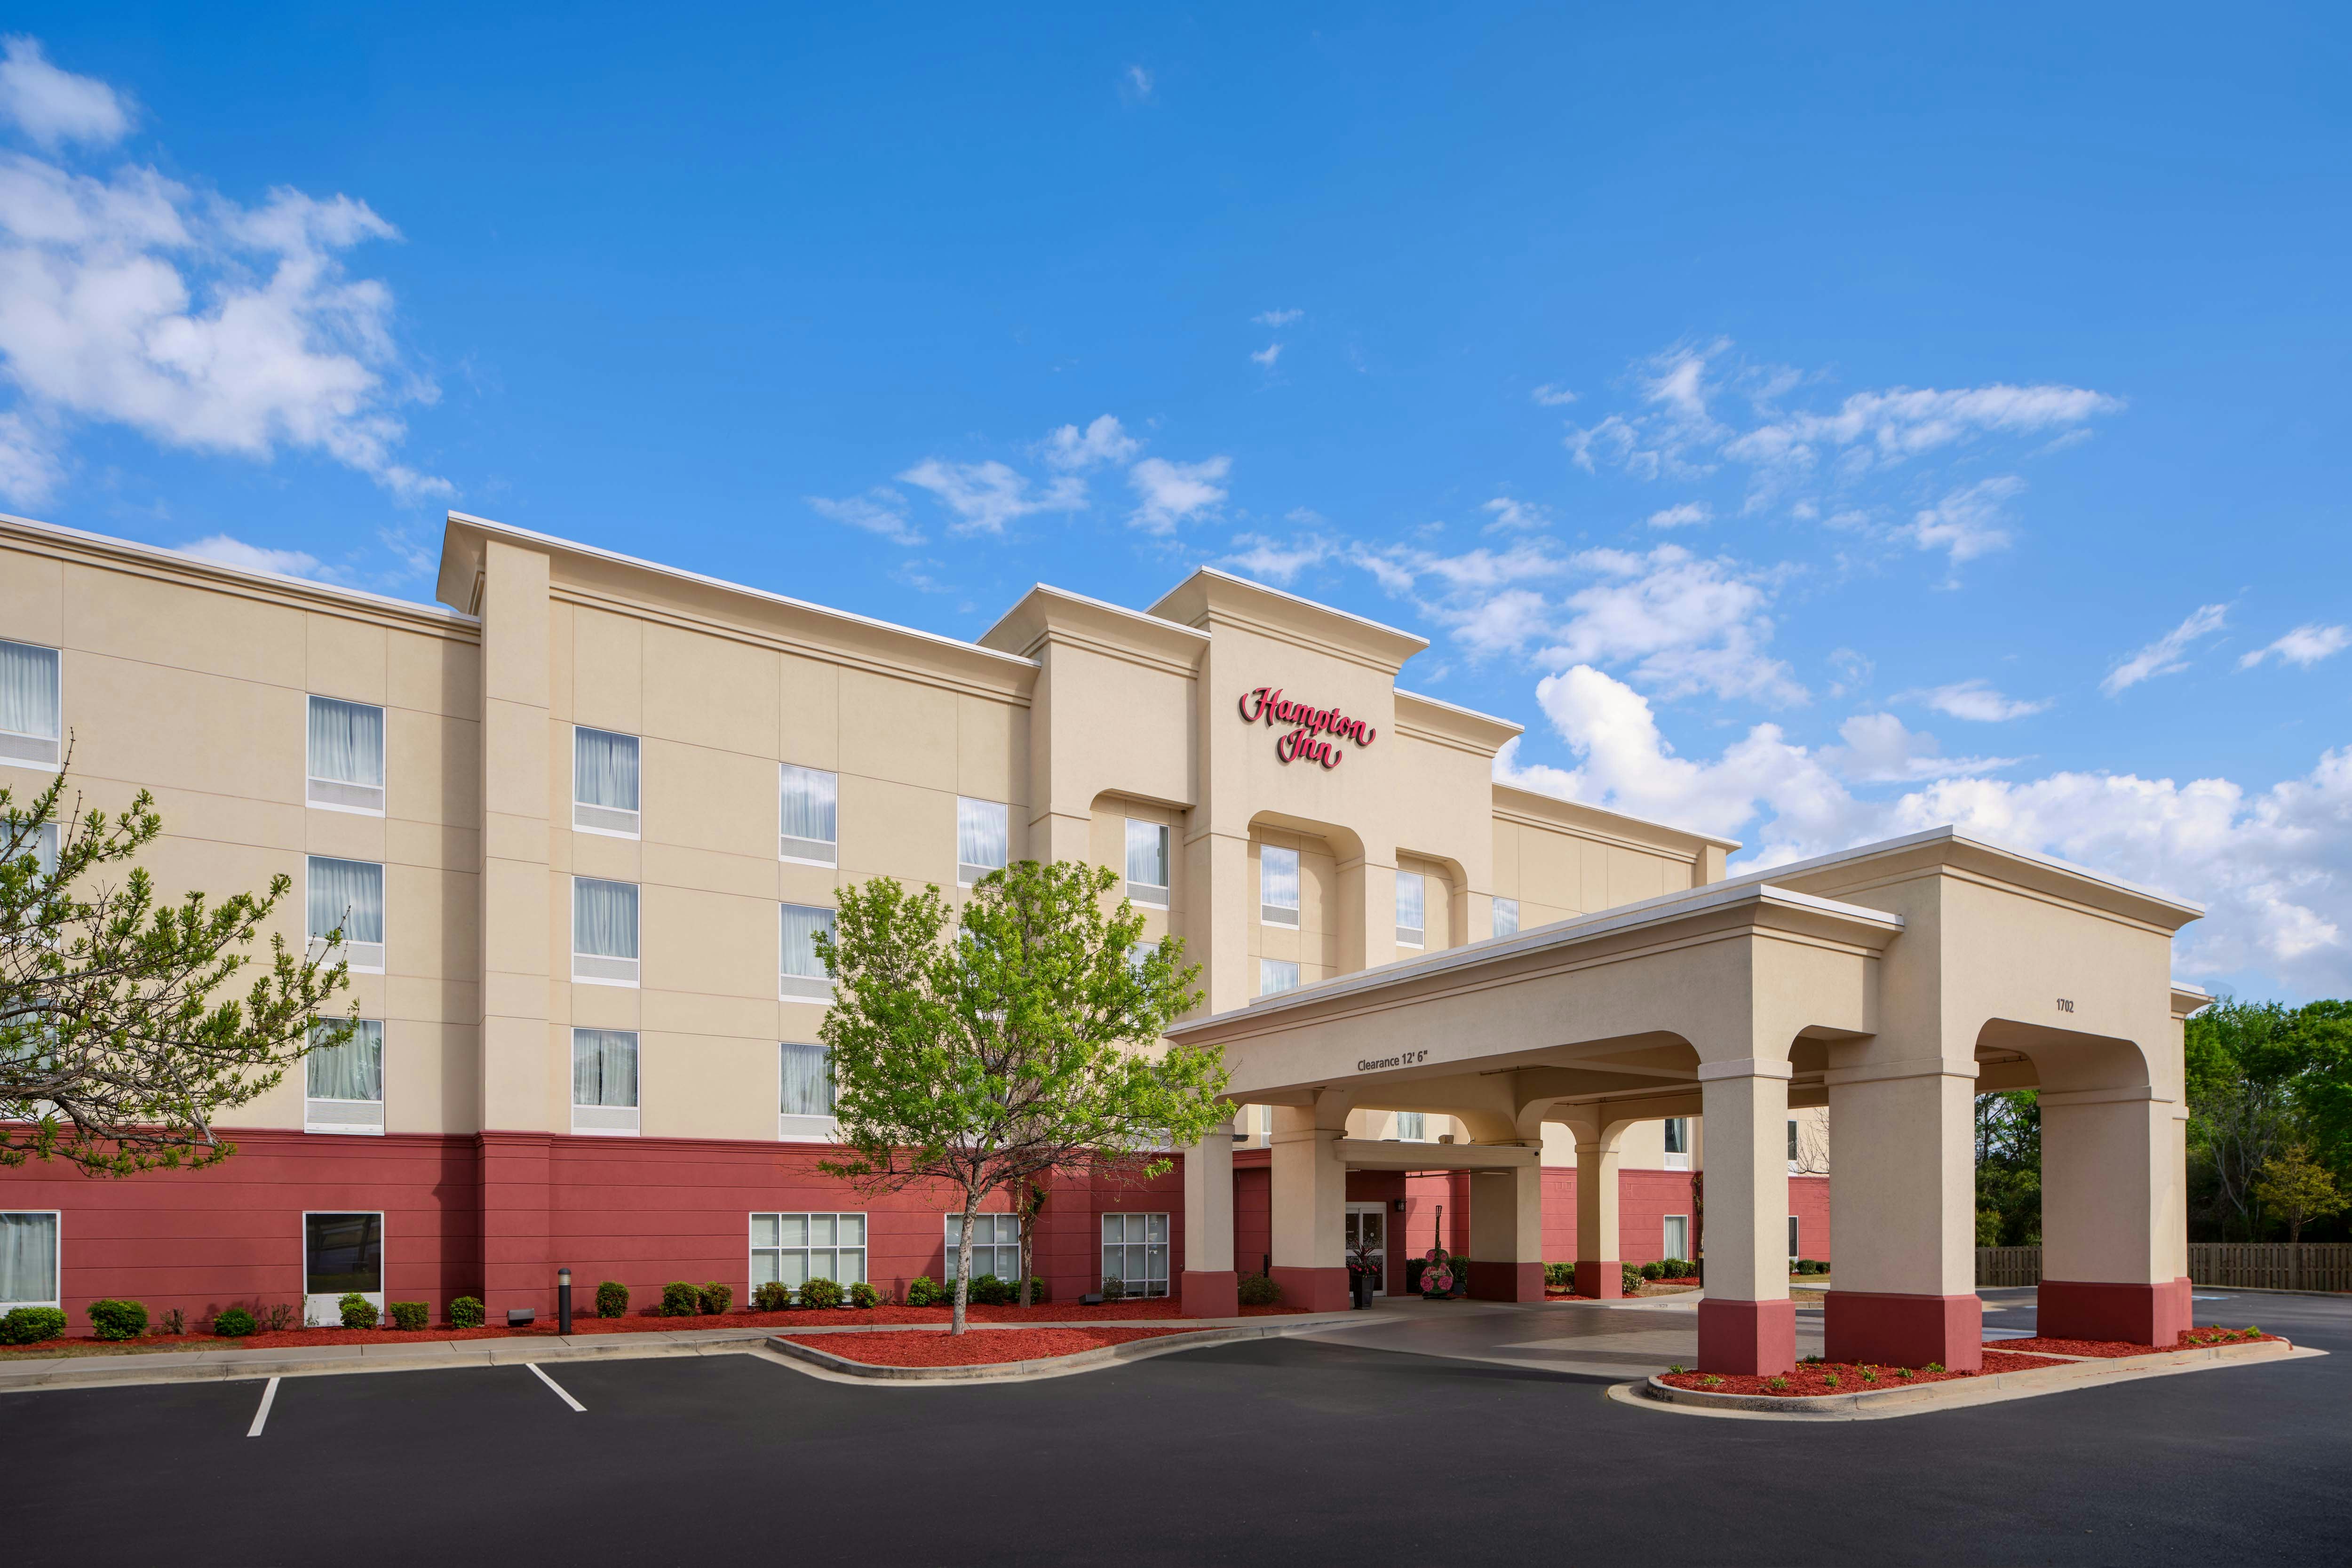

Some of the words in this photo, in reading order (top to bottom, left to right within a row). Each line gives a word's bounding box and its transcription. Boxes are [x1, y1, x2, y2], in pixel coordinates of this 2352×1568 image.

[1240, 687, 1376, 746] Hampton
[1278, 728, 1342, 768] Inn
[2057, 998, 2074, 1013] 1702
[1358, 1057, 1399, 1071] Clearance
[1402, 1052, 1414, 1064] 12'
[1417, 1050, 1428, 1062] 6"
